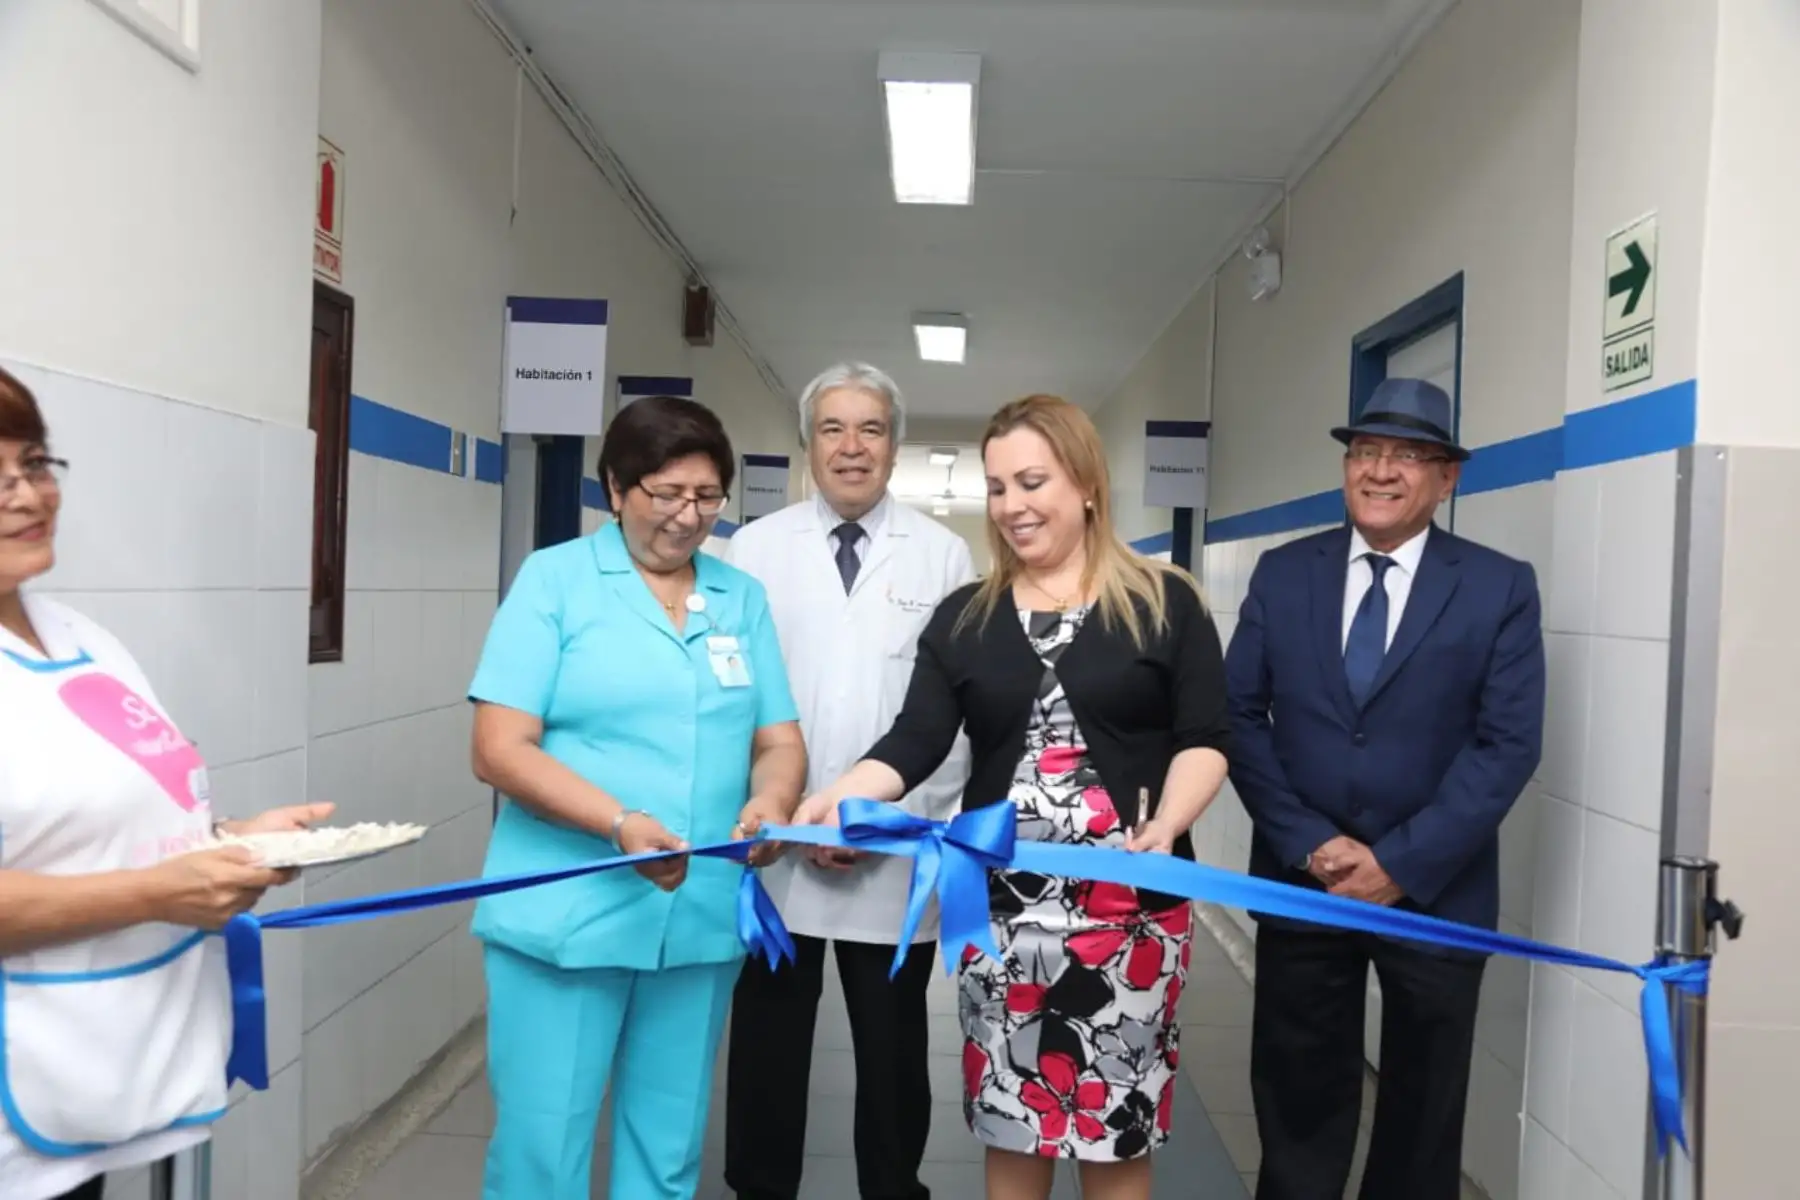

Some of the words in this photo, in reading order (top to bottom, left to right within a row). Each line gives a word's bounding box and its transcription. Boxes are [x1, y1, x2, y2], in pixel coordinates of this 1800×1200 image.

[1606, 343, 1649, 377] SALIDA
[515, 367, 582, 381] Habitación
[586, 369, 592, 381] 1
